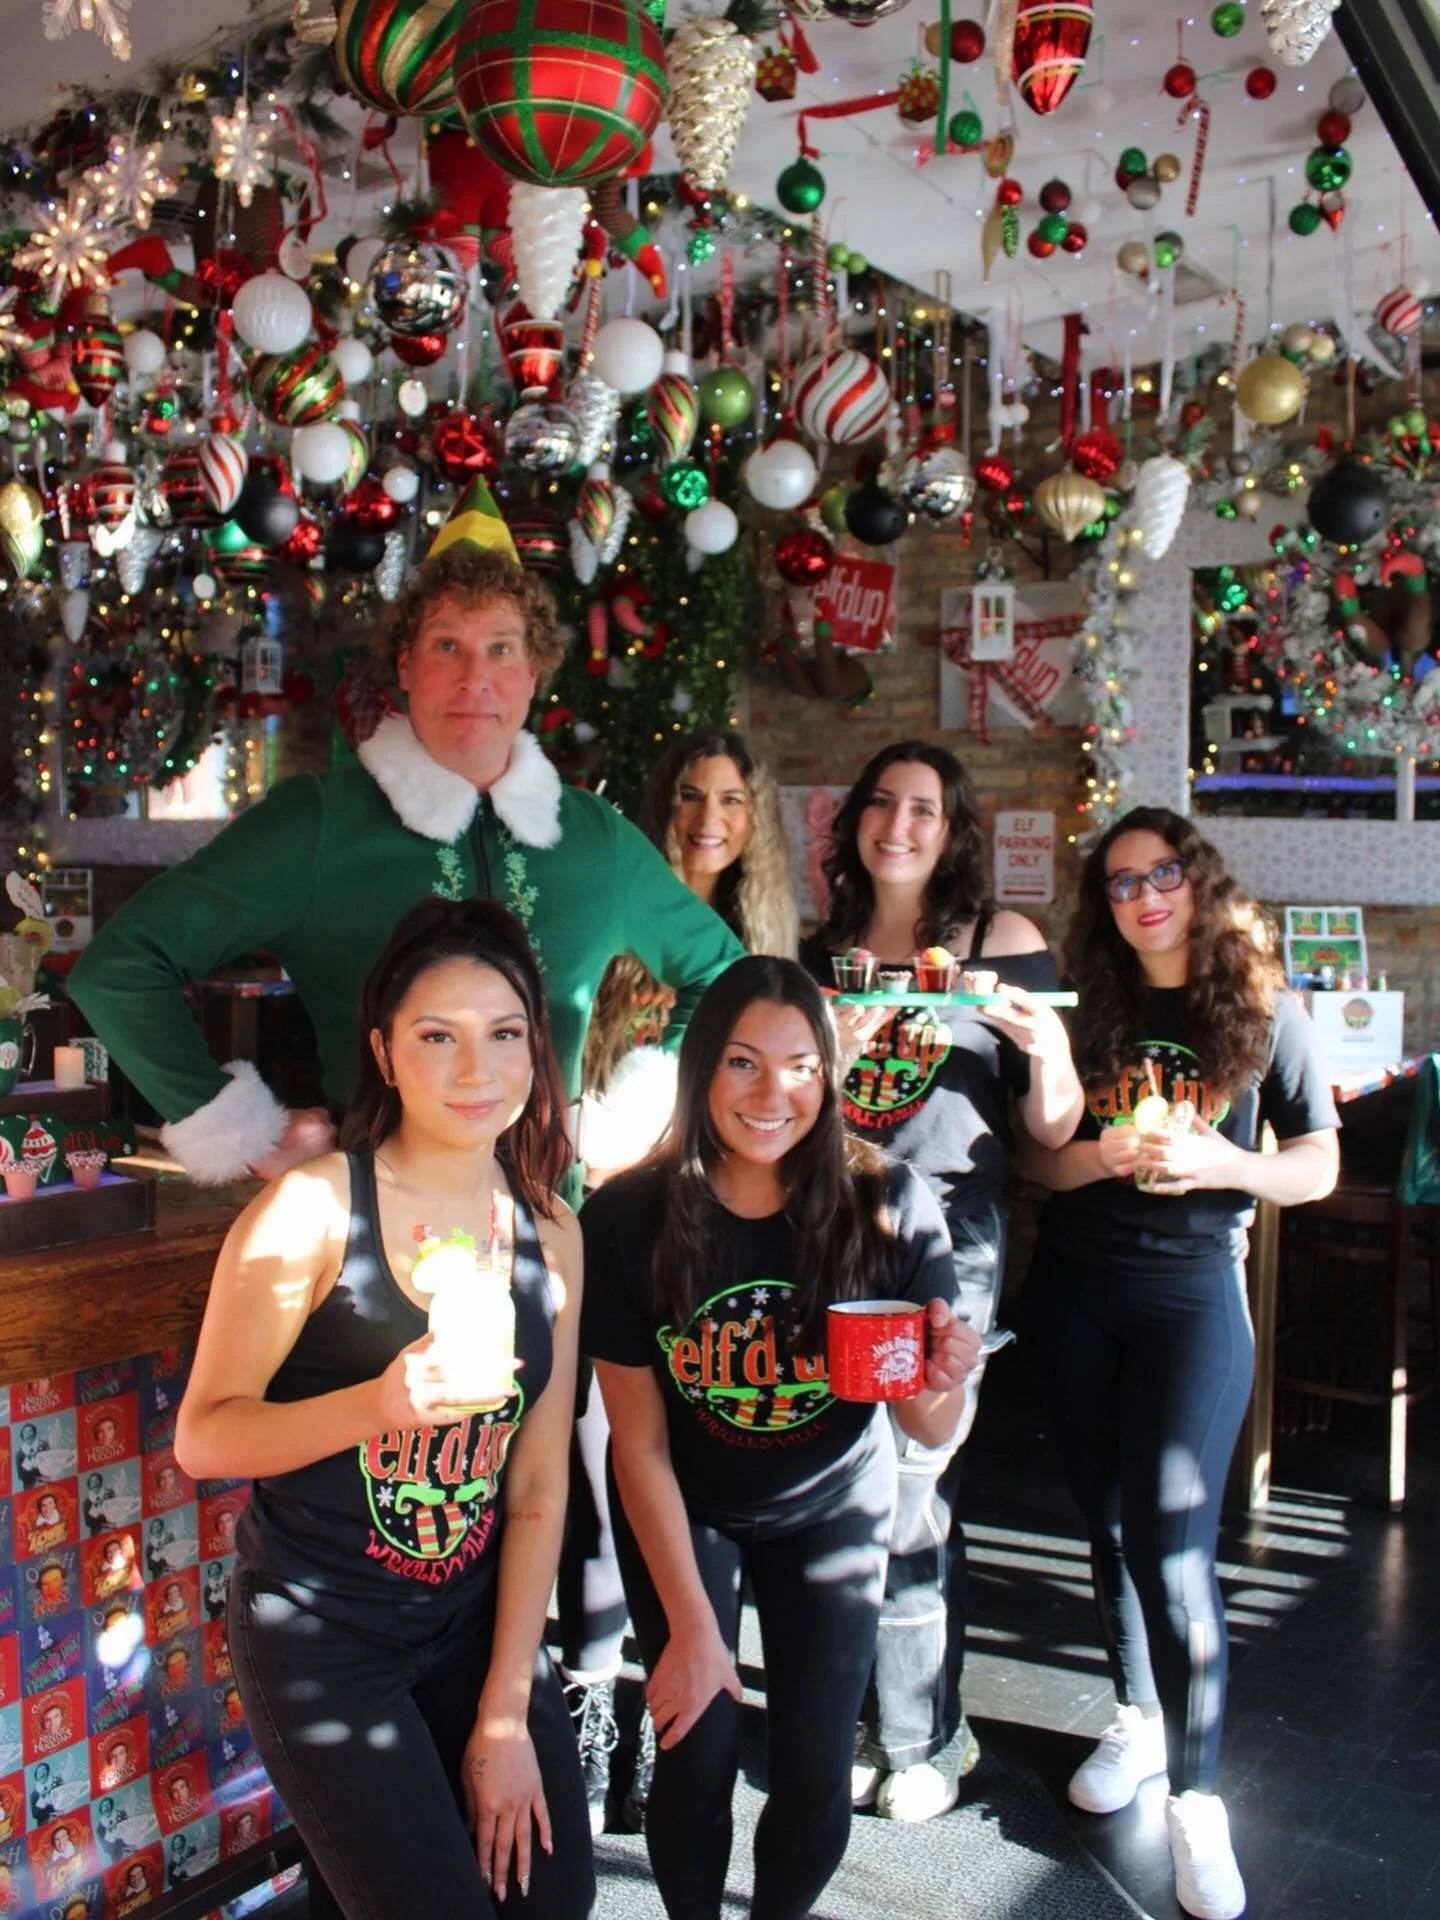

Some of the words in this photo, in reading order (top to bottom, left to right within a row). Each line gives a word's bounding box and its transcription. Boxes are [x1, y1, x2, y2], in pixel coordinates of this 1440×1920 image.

[1013, 818, 1036, 832] ELF
[998, 835, 1052, 850] PARKING
[1007, 853, 1041, 867] ONLY
[671, 1316, 781, 1388] elf'd
[791, 1352, 830, 1382] u
